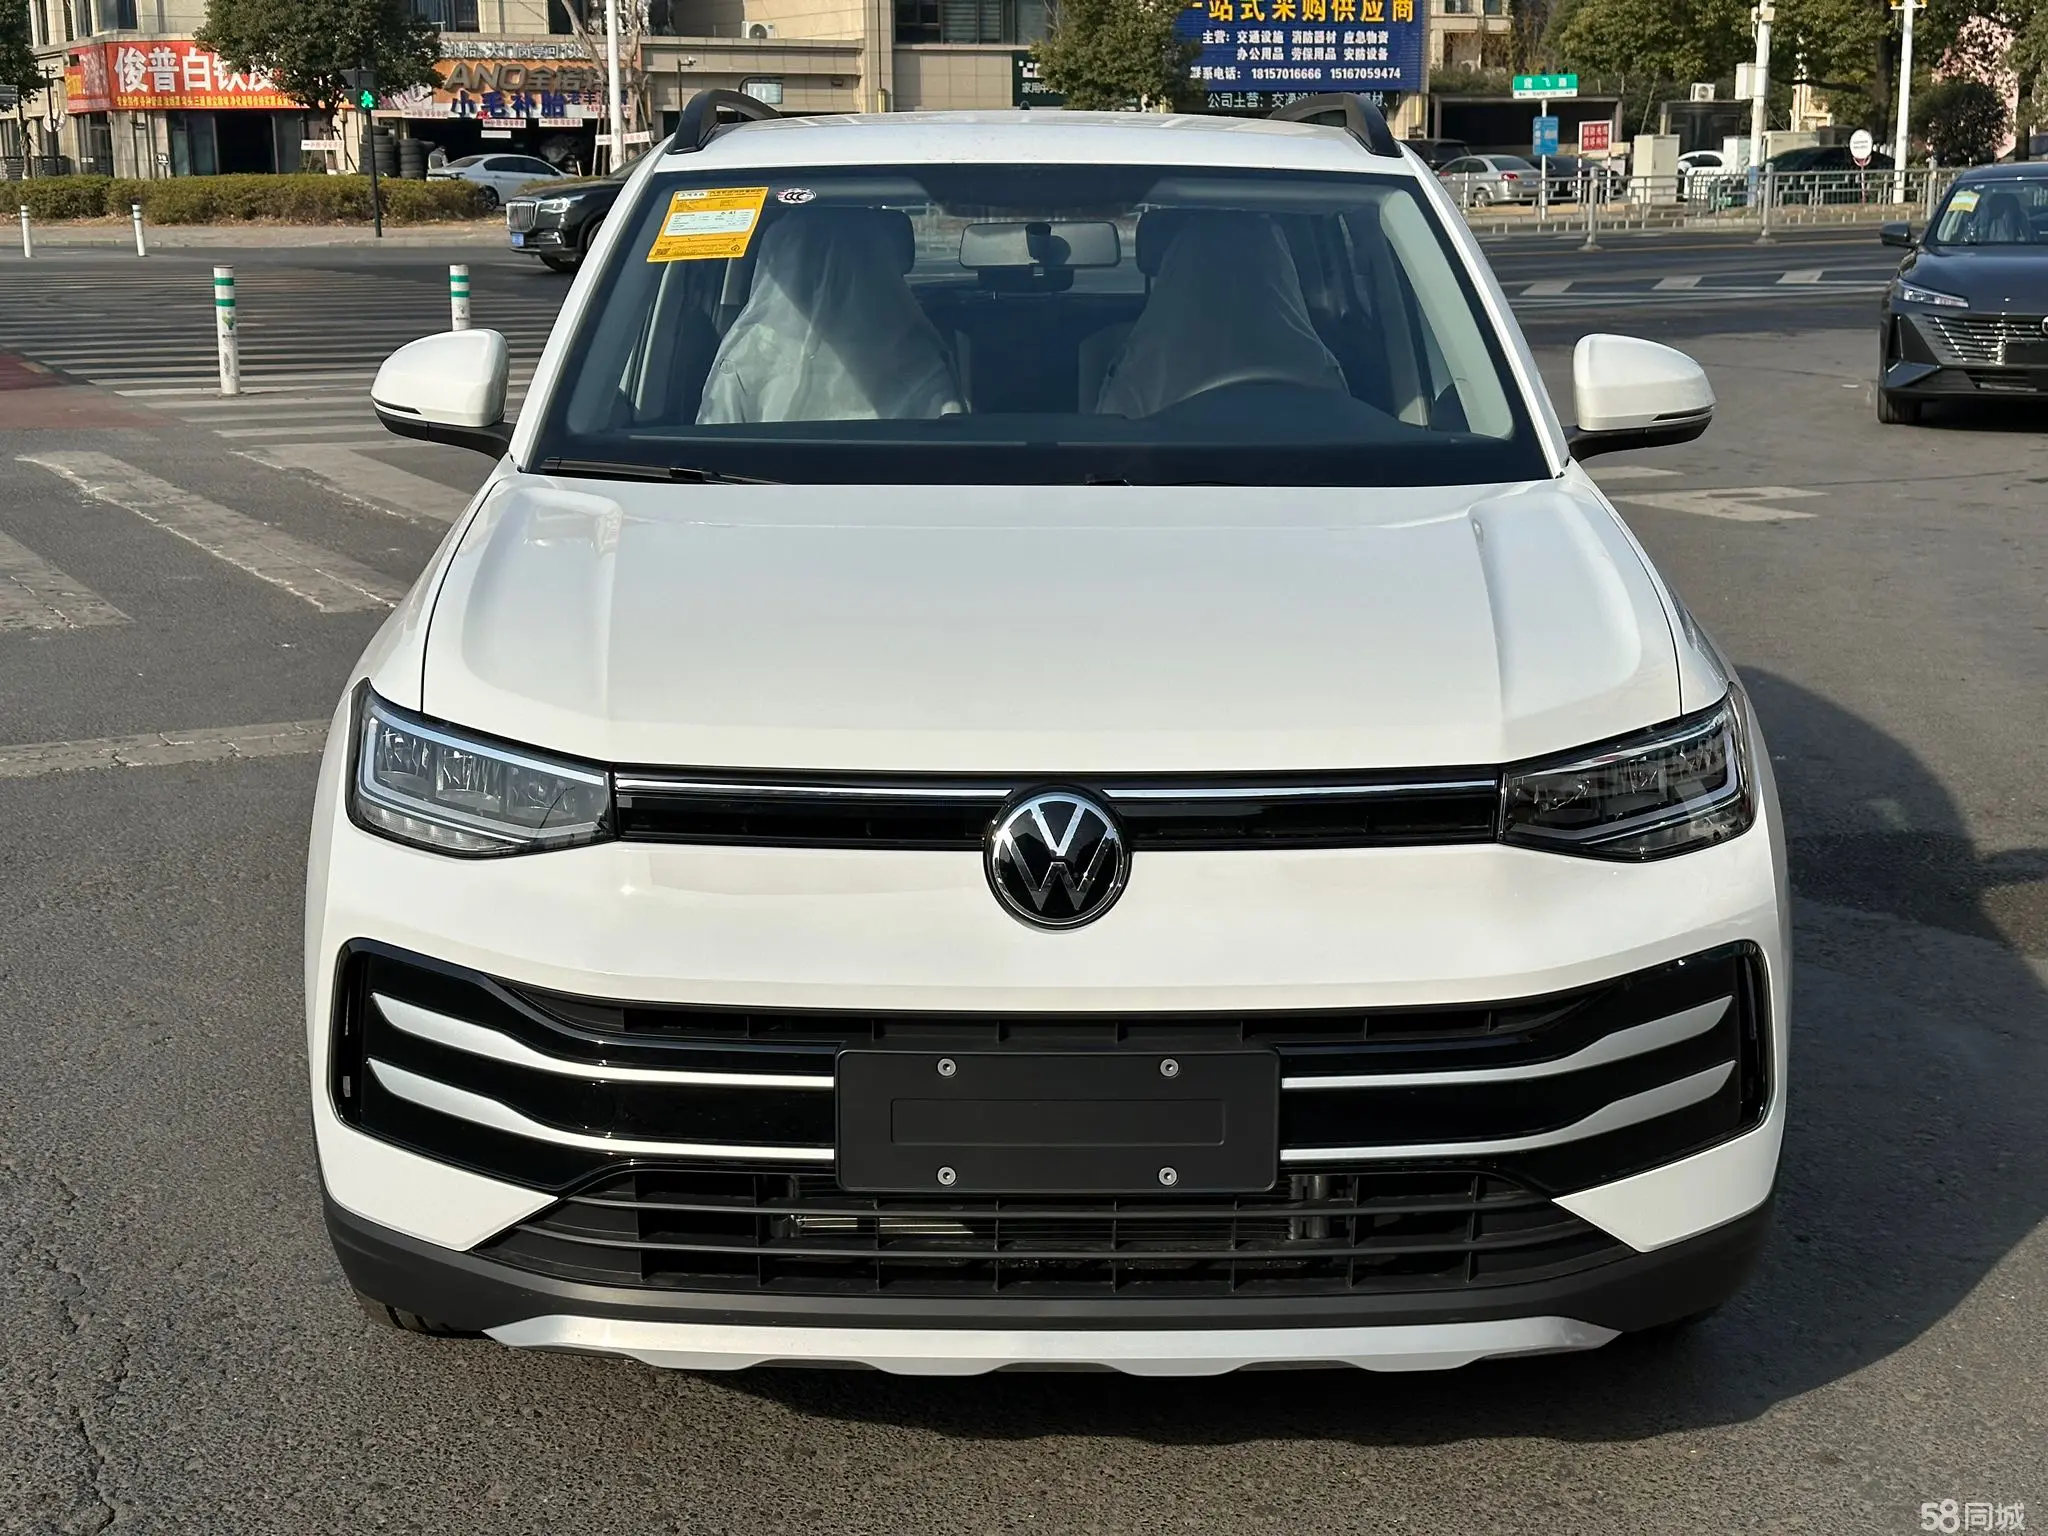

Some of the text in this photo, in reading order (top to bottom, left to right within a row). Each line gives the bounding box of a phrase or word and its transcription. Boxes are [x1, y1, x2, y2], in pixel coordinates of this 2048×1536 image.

[1236, 30, 1284, 44] 交通设施
[1291, 30, 1337, 44] 消防器材
[1343, 30, 1389, 44] 应急物资
[1236, 47, 1389, 61] 办公用品 劳保用品 安防设备
[1251, 67, 1322, 80] 18157016666
[1330, 67, 1401, 80] 15167059474
[451, 91, 567, 119] 小毛补胎
